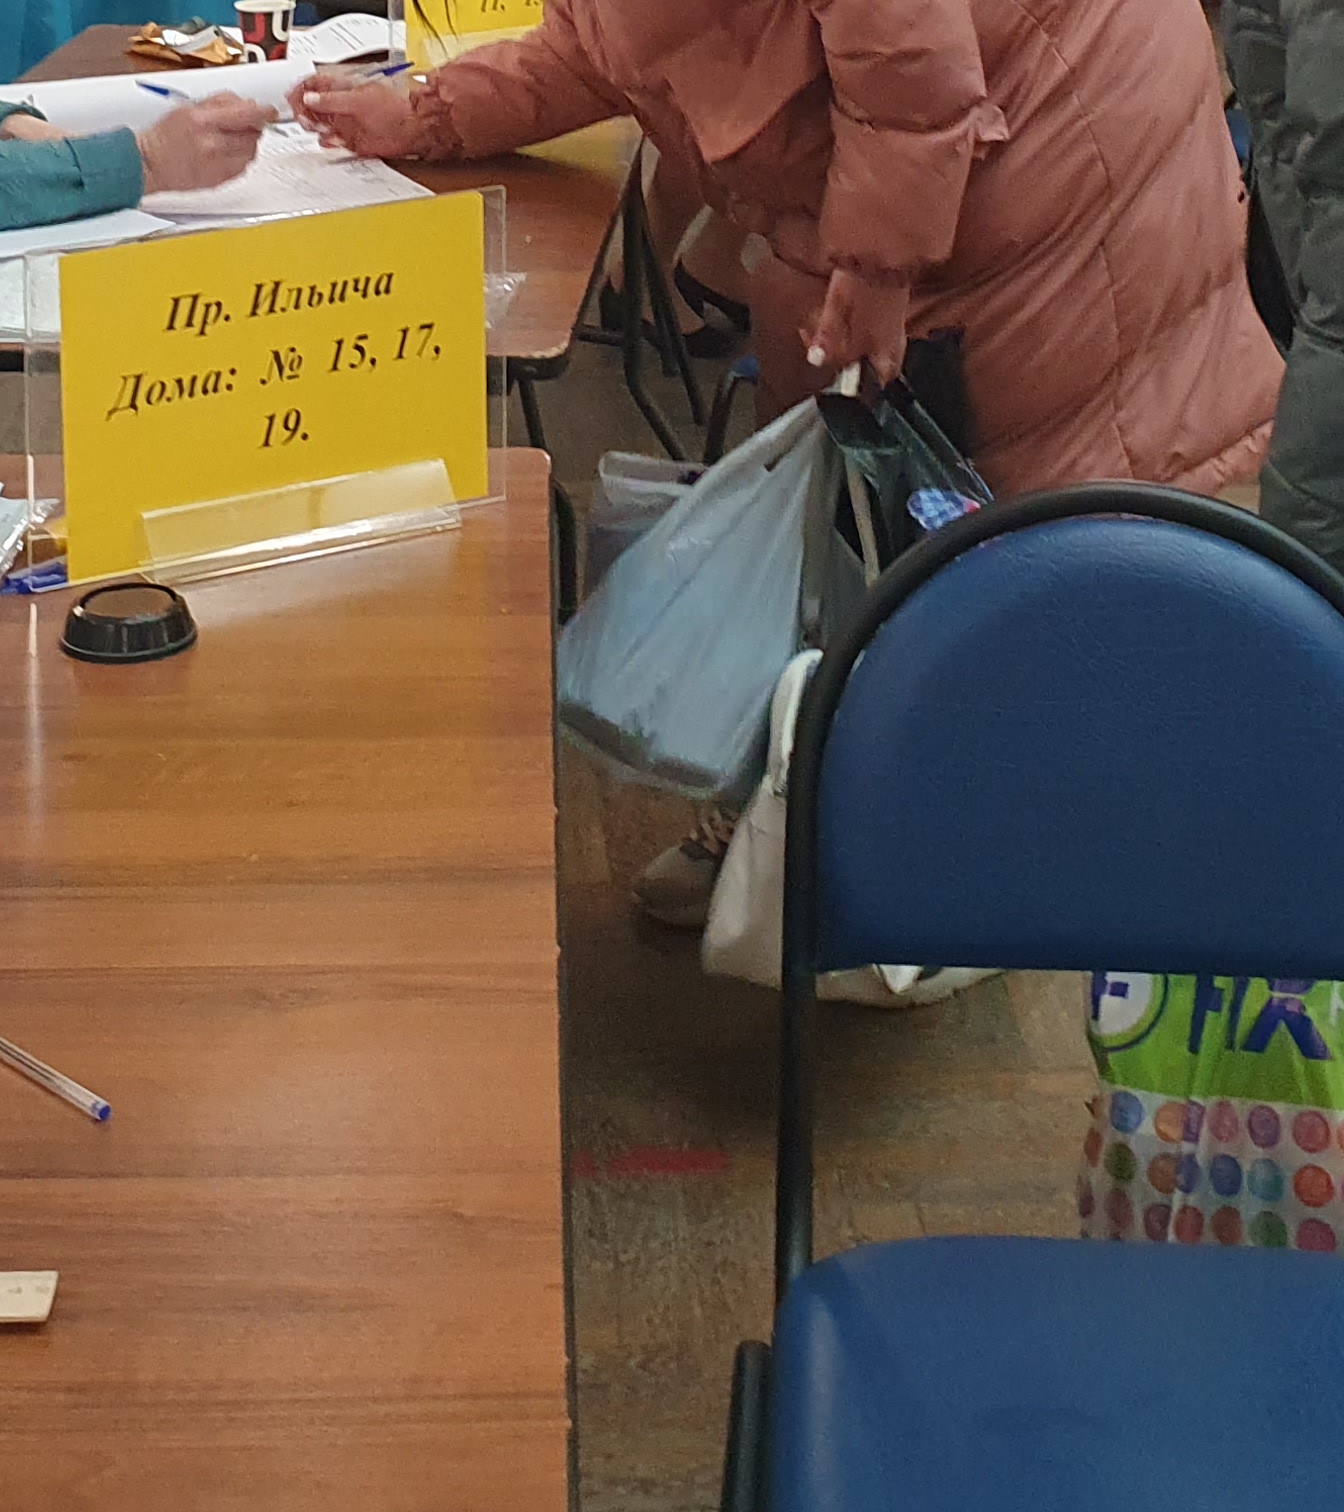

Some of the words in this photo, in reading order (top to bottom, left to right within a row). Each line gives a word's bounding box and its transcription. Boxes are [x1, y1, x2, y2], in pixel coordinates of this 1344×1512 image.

[165, 293, 231, 337] Пр.
[246, 271, 395, 319] Ильича
[106, 367, 237, 420] Дома:
[259, 347, 304, 386] №
[327, 334, 378, 375] 15,
[394, 322, 443, 364] 17,
[259, 409, 310, 449] 19.
